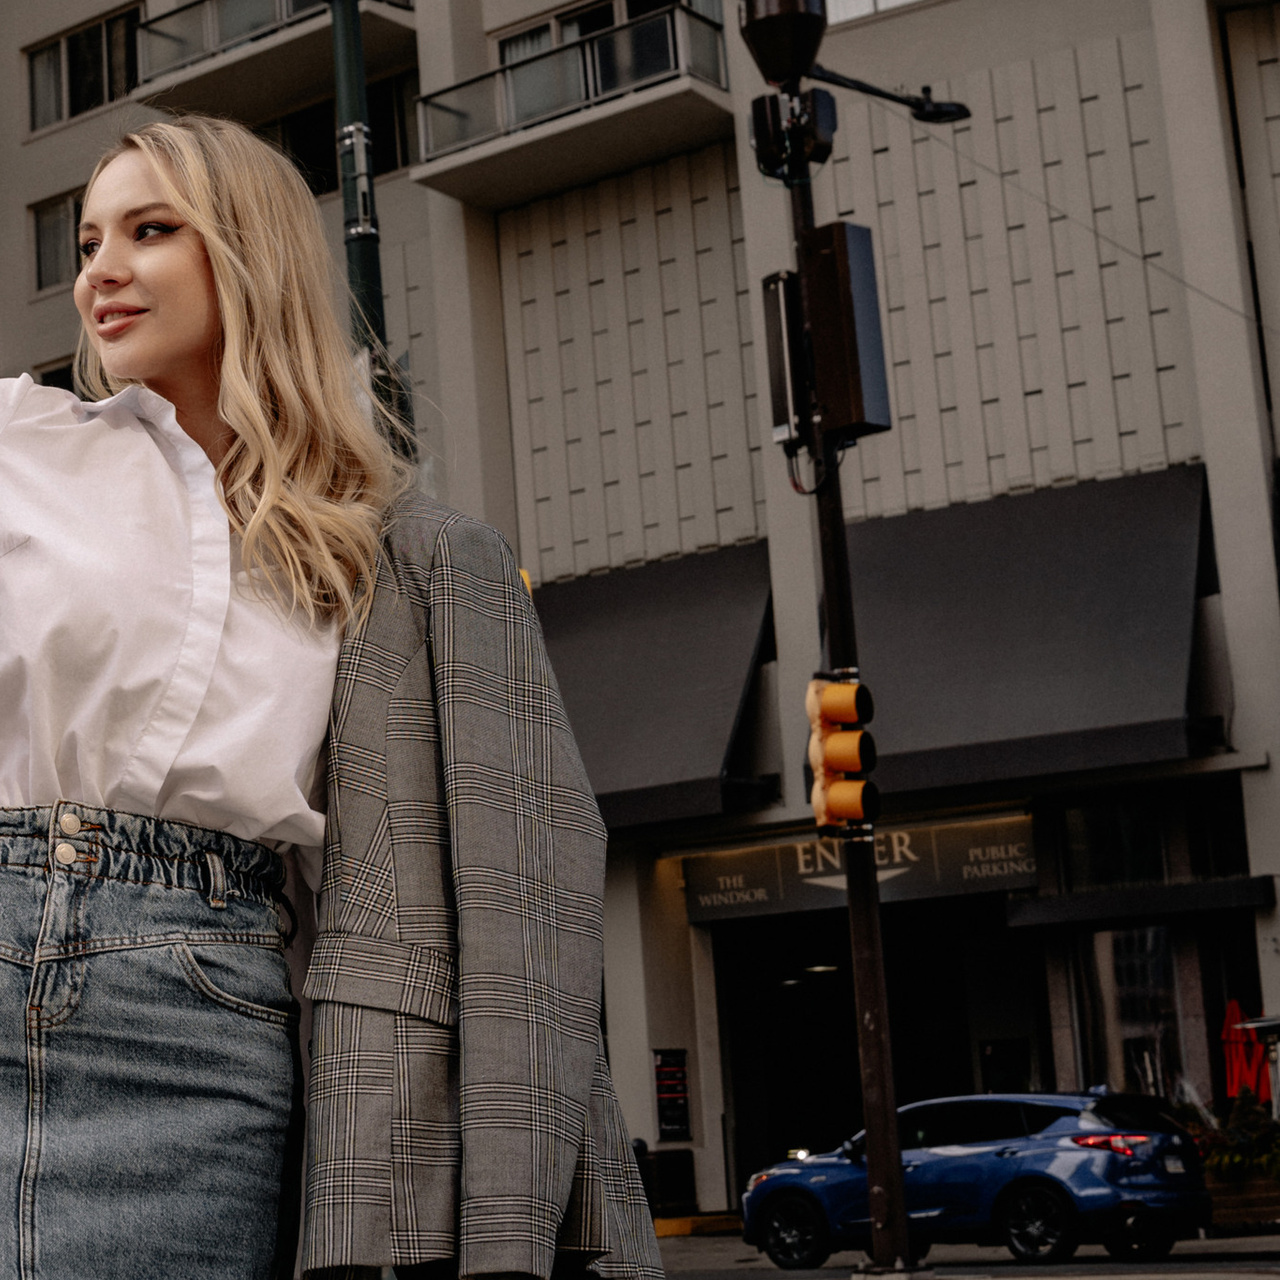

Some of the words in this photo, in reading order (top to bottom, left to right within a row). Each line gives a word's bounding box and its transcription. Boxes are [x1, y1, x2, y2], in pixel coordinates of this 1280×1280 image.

[797, 831, 919, 874] ENER
[968, 842, 1028, 863] PUBLIC
[962, 858, 1037, 880] PARKING
[717, 874, 745, 891] THE
[698, 888, 769, 907] WINDSOR
